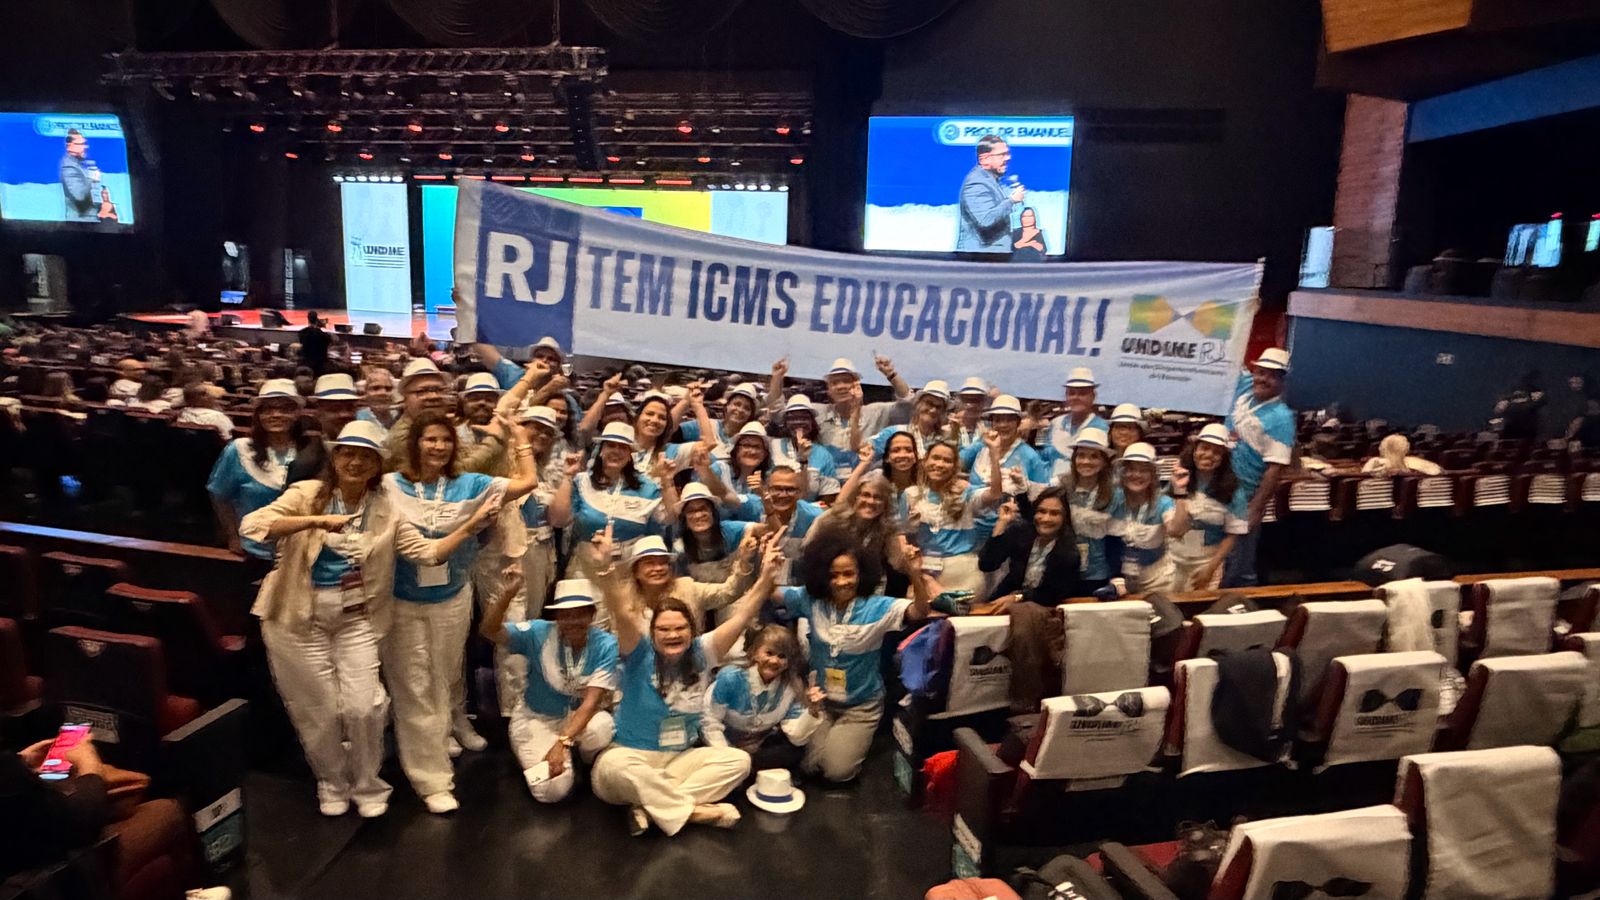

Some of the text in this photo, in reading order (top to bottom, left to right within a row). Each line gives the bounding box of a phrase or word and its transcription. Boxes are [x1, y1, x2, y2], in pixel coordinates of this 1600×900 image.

[485, 231, 1111, 357] RJ TEM ICMS EDUCACIONAL!
[1121, 337, 1197, 358] UNDIME
